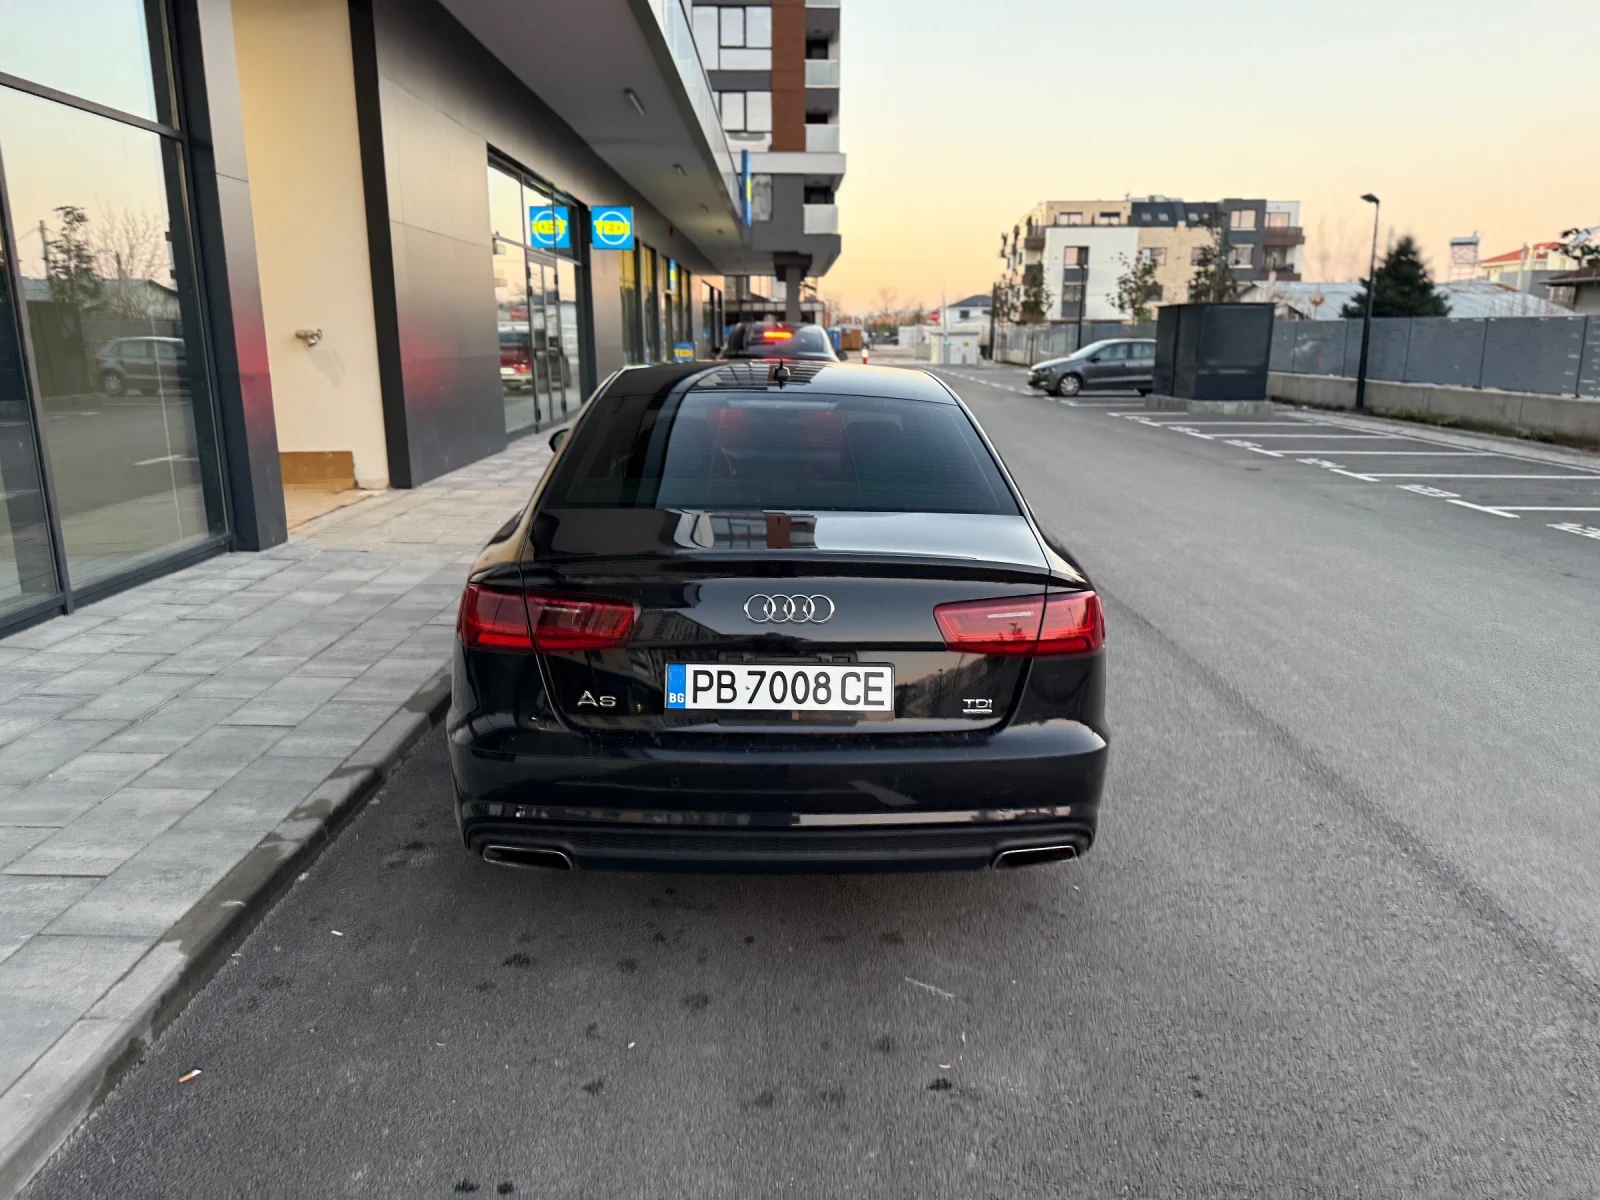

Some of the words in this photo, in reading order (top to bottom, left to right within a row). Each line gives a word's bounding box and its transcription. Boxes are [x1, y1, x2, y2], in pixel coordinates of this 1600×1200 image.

[692, 669, 738, 704] PB
[747, 670, 832, 705] 7008
[840, 671, 885, 706] CE
[577, 690, 617, 707] A6
[669, 692, 685, 703] BG
[962, 698, 993, 708] TDI
